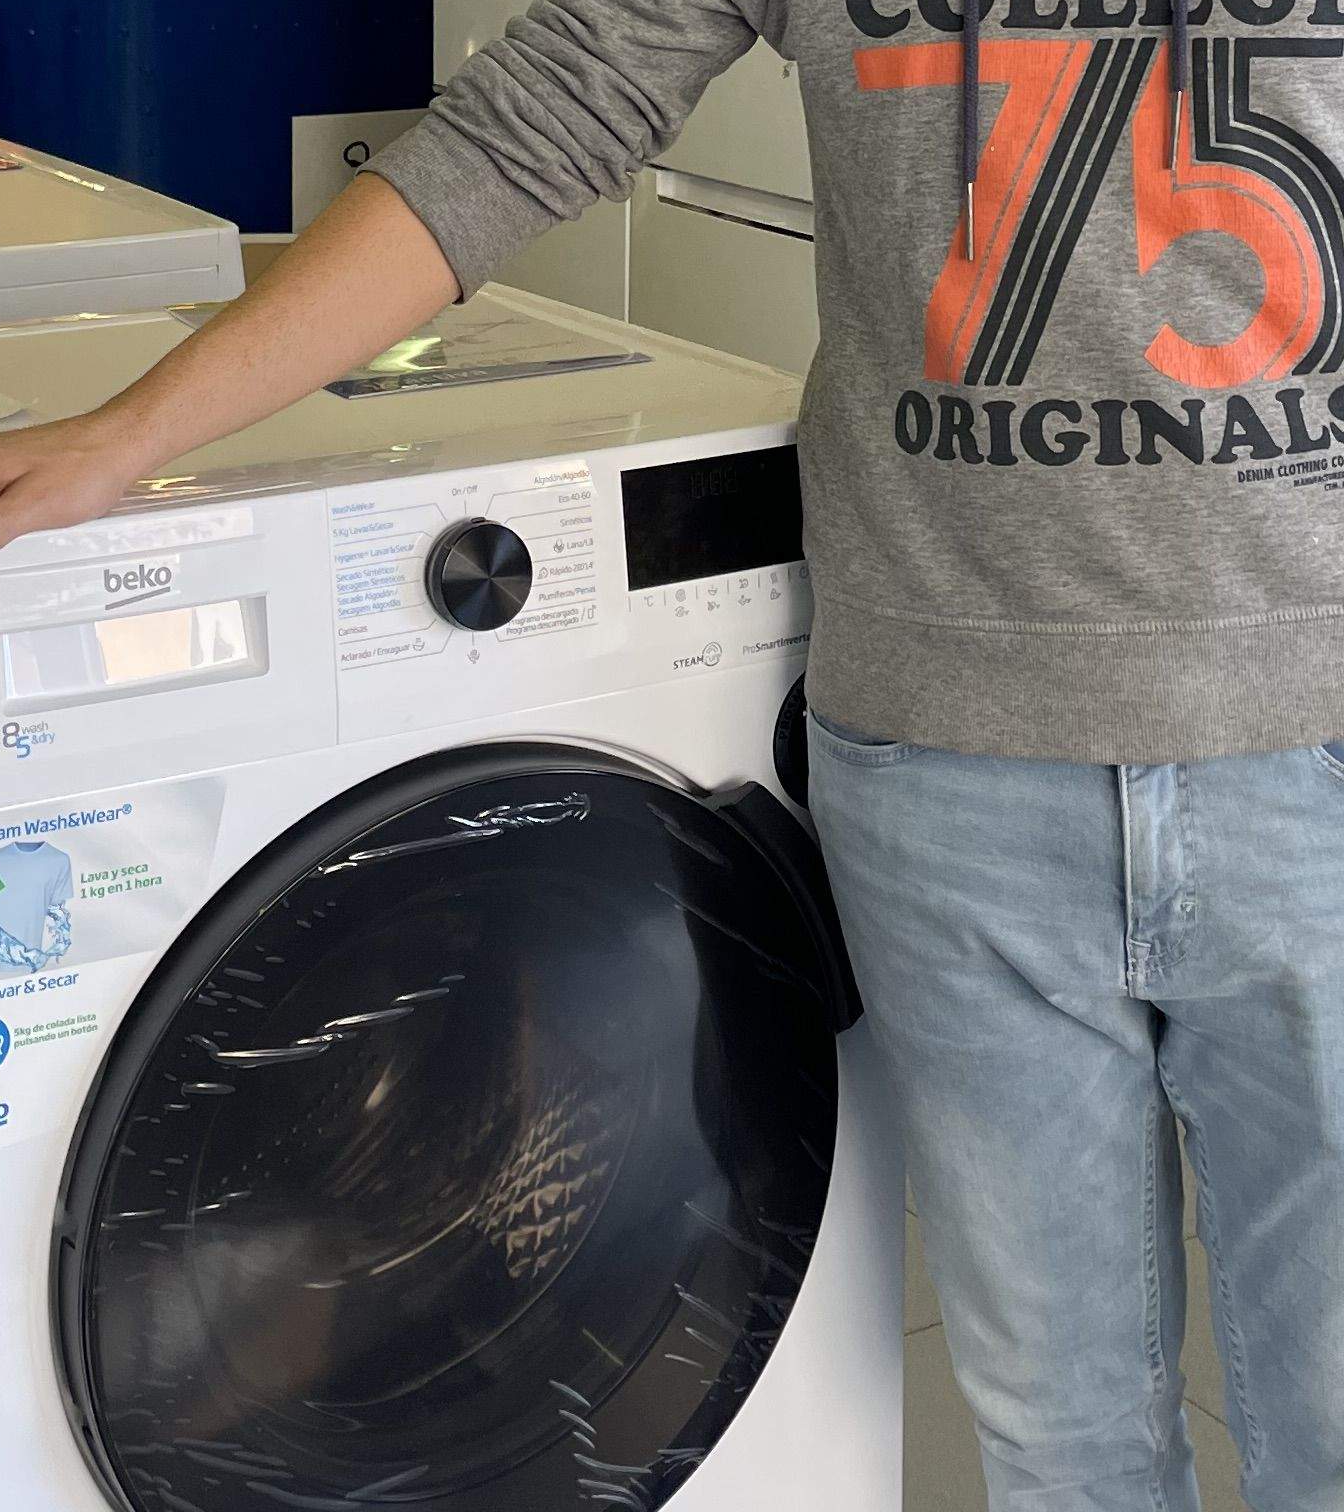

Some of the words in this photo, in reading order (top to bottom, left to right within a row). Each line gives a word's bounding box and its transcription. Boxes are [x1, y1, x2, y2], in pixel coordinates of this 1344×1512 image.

[1237, 467, 1275, 483] DENIM
[1278, 458, 1328, 478] CLOTHING
[466, 485, 478, 493] Off
[104, 565, 171, 593] beko
[341, 650, 371, 662] Aclarado
[674, 656, 703, 669] STEAM
[3, 722, 20, 748] 8
[22, 721, 48, 734] wash
[17, 736, 30, 758] 5
[80, 870, 108, 885] Lava
[111, 869, 118, 881] y
[121, 862, 148, 876] seca
[80, 888, 86, 899] 1
[90, 883, 105, 899] kg
[108, 882, 124, 895] en
[125, 880, 131, 891] 1
[134, 875, 162, 890] hora
[24, 980, 35, 994] &
[38, 971, 80, 991] Secar
[14, 1026, 30, 1039] 5kg
[32, 1024, 43, 1034] de
[45, 1017, 76, 1032] colada
[77, 1013, 97, 1025] lista
[14, 1032, 56, 1049] pulsando
[58, 1030, 68, 1039] un
[70, 1023, 98, 1037] botón
